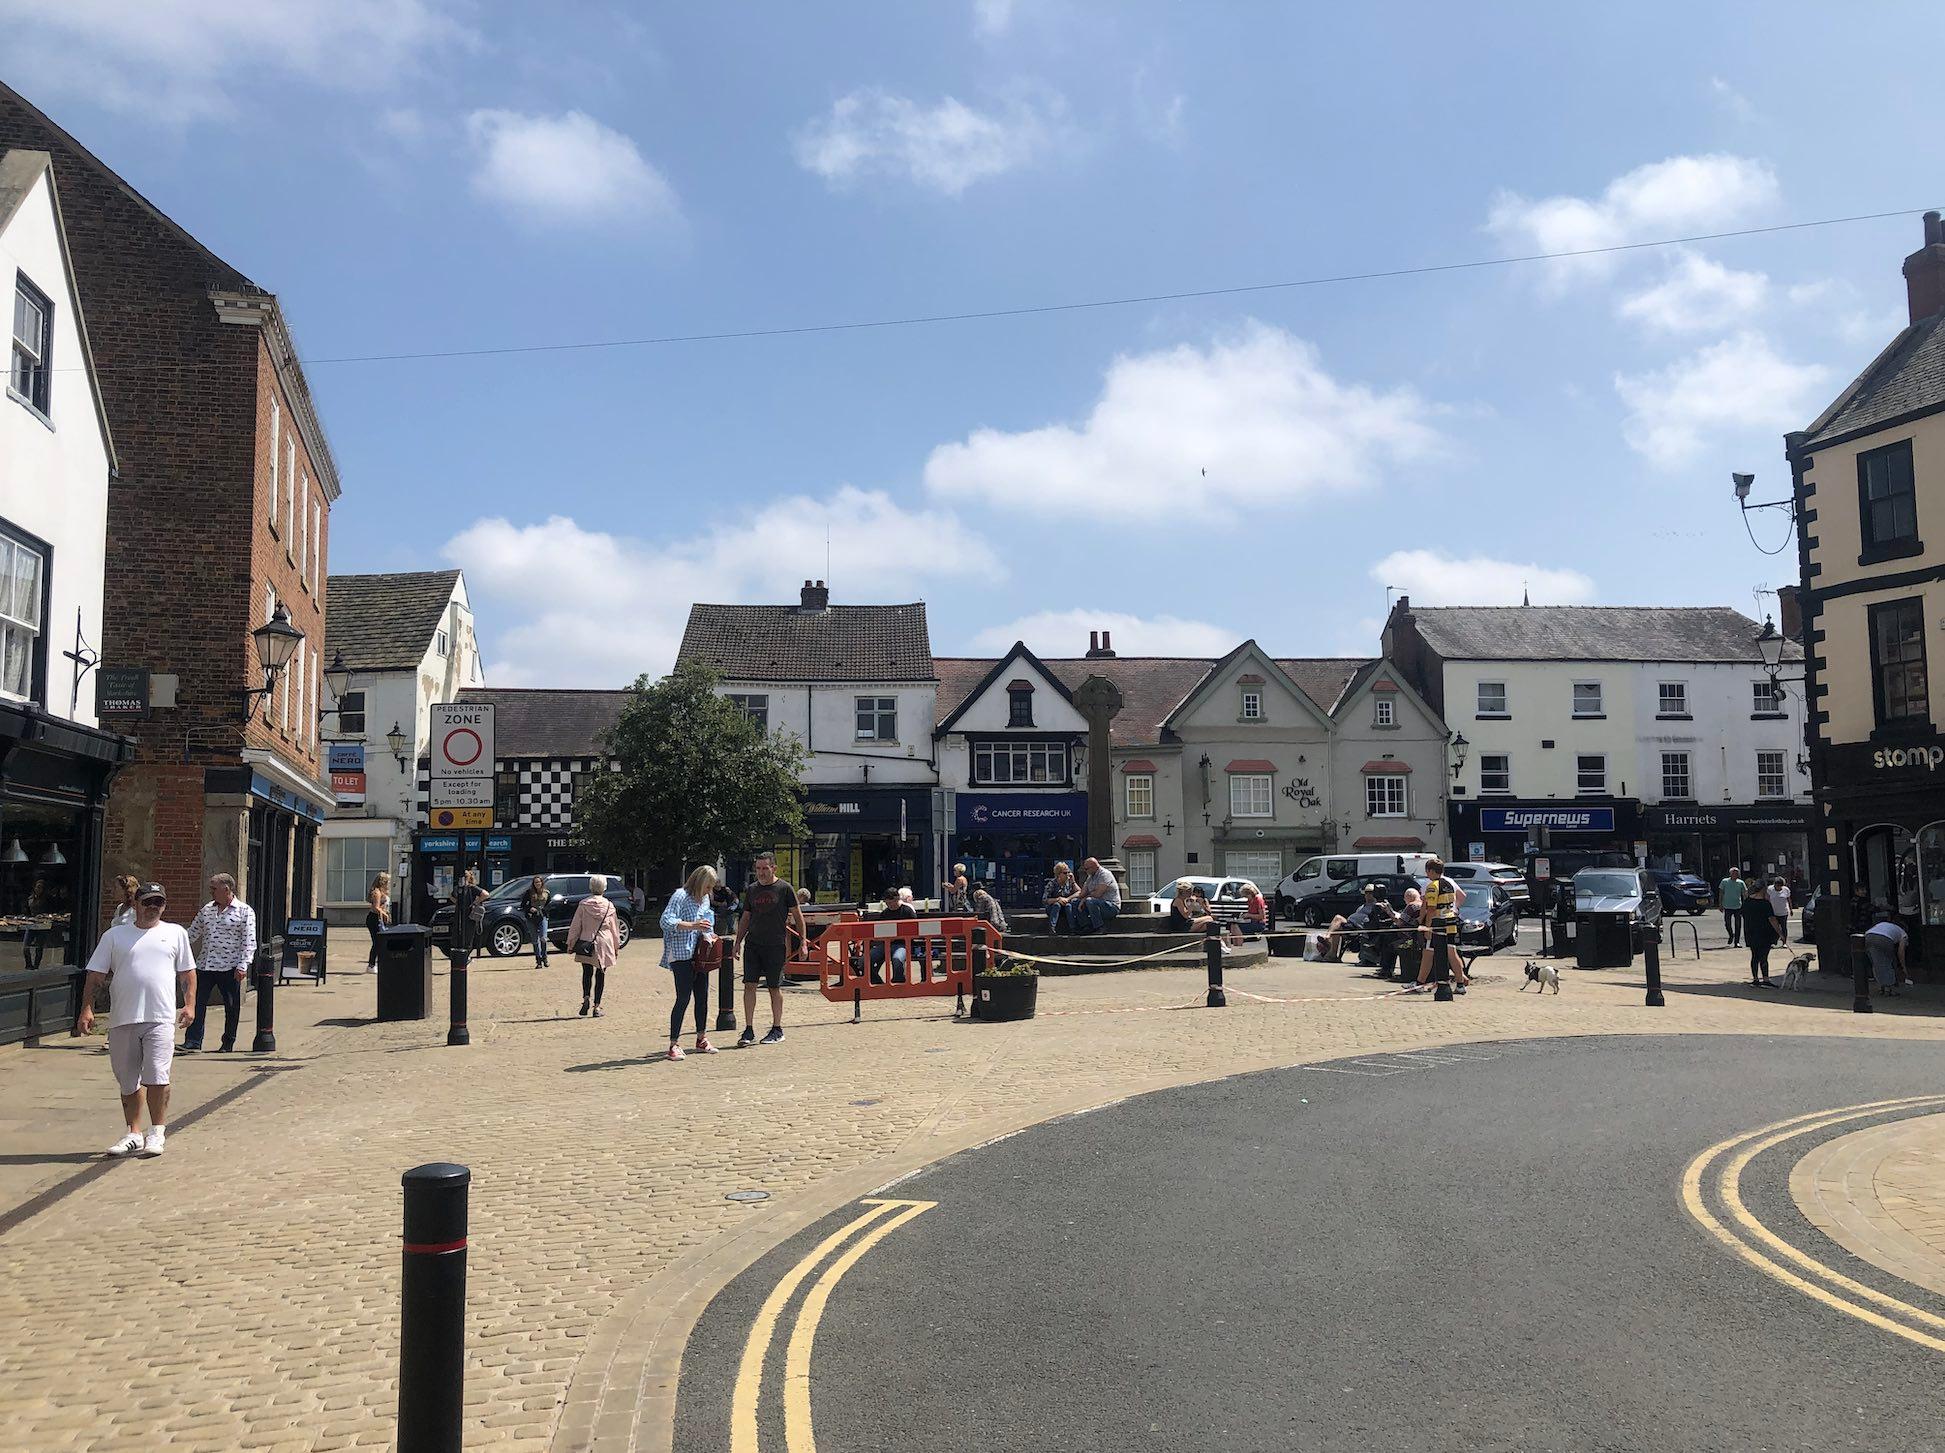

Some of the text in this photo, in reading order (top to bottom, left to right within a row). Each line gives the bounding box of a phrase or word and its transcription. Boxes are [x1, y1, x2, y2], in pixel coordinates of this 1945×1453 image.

[444, 714, 482, 724] ZONE
[1873, 745, 1945, 772] stomp
[332, 776, 359, 786] TO LET
[442, 780, 482, 788] Except for
[1291, 777, 1309, 788] Old
[448, 788, 477, 796] loading
[1281, 786, 1315, 801] Royal
[839, 802, 861, 813] HILL
[1299, 796, 1322, 809] Oak
[991, 809, 1072, 818] CANCER RESEARCH UK
[1504, 811, 1591, 828] Supernews
[1664, 813, 1717, 825] Harriets
[424, 839, 456, 848] yorkshire
[546, 838, 567, 847] THE
